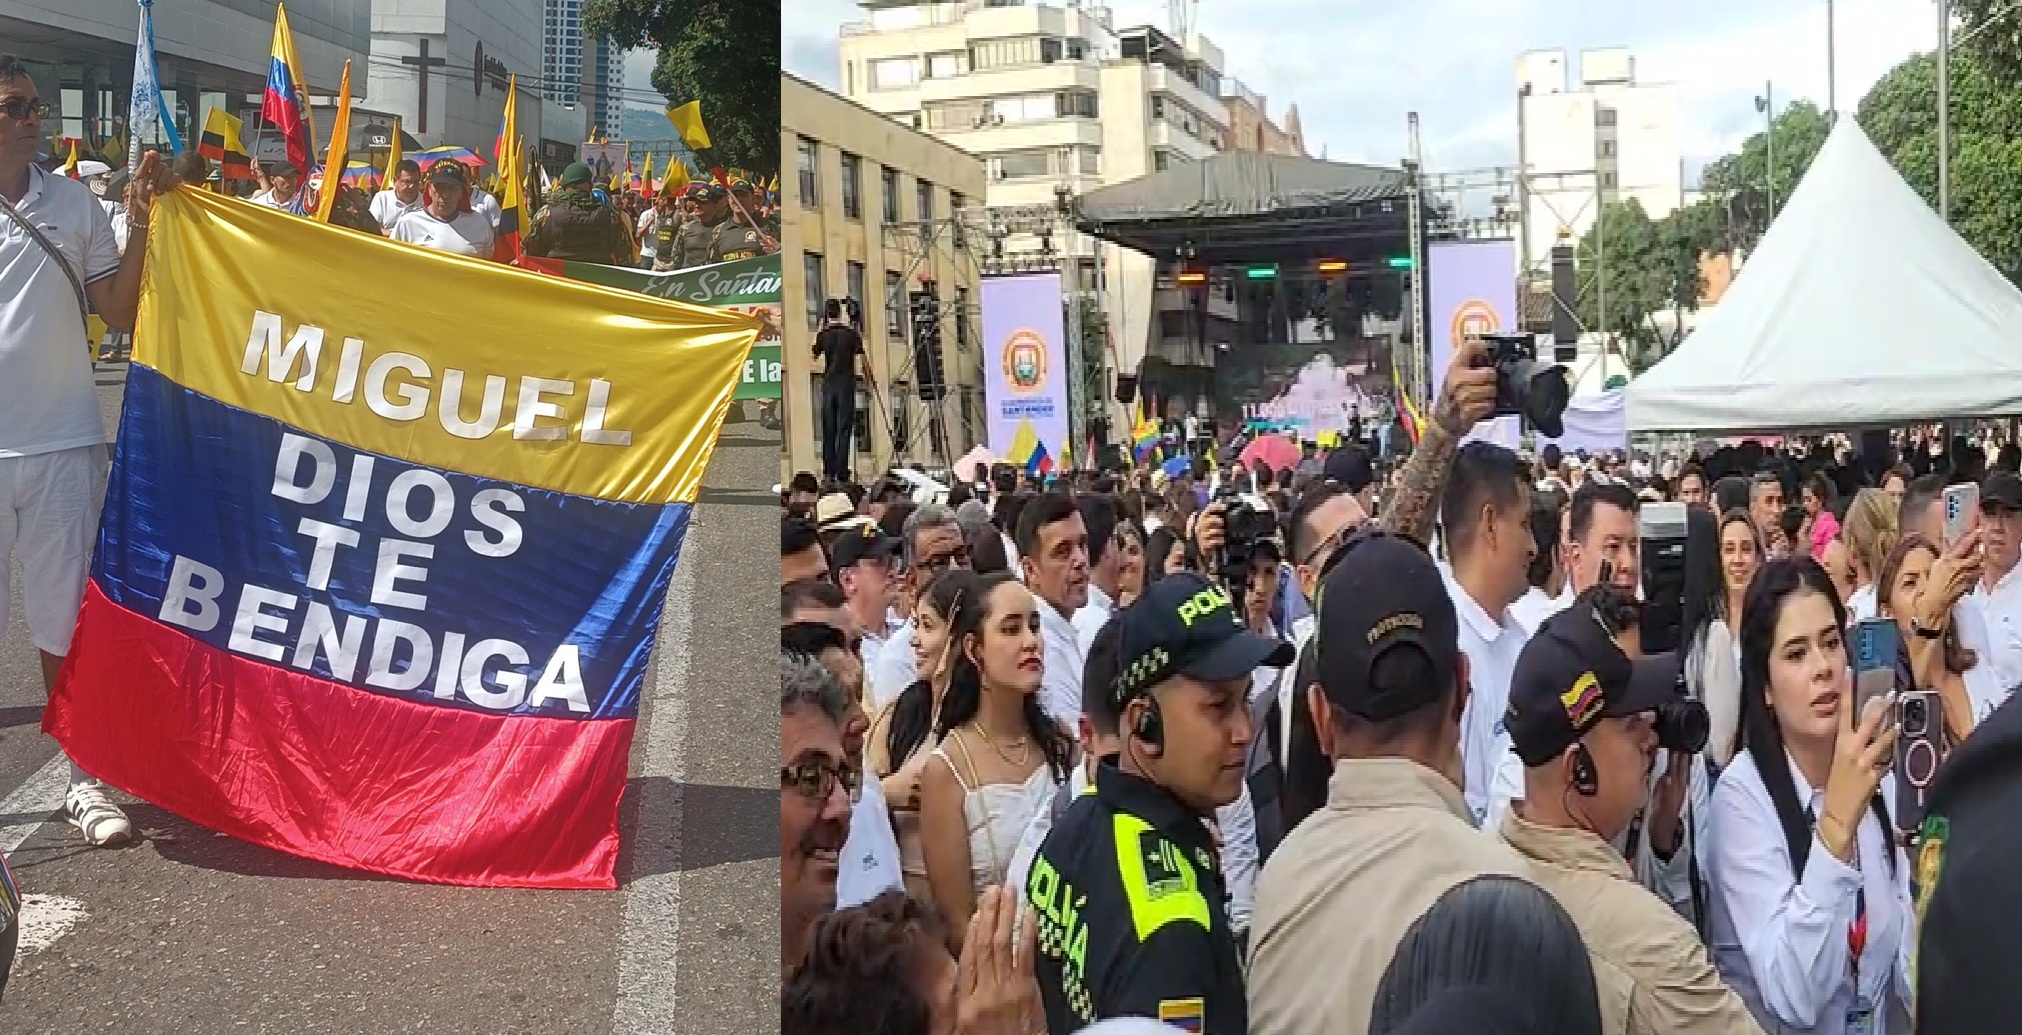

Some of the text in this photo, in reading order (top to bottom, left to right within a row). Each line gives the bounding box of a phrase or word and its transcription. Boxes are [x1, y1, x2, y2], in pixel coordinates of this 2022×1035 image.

[641, 275, 686, 298] En
[240, 309, 633, 447] MIGUEL
[271, 432, 526, 557] DIOS
[297, 518, 435, 611] TE
[158, 554, 591, 713] BENDIGA
